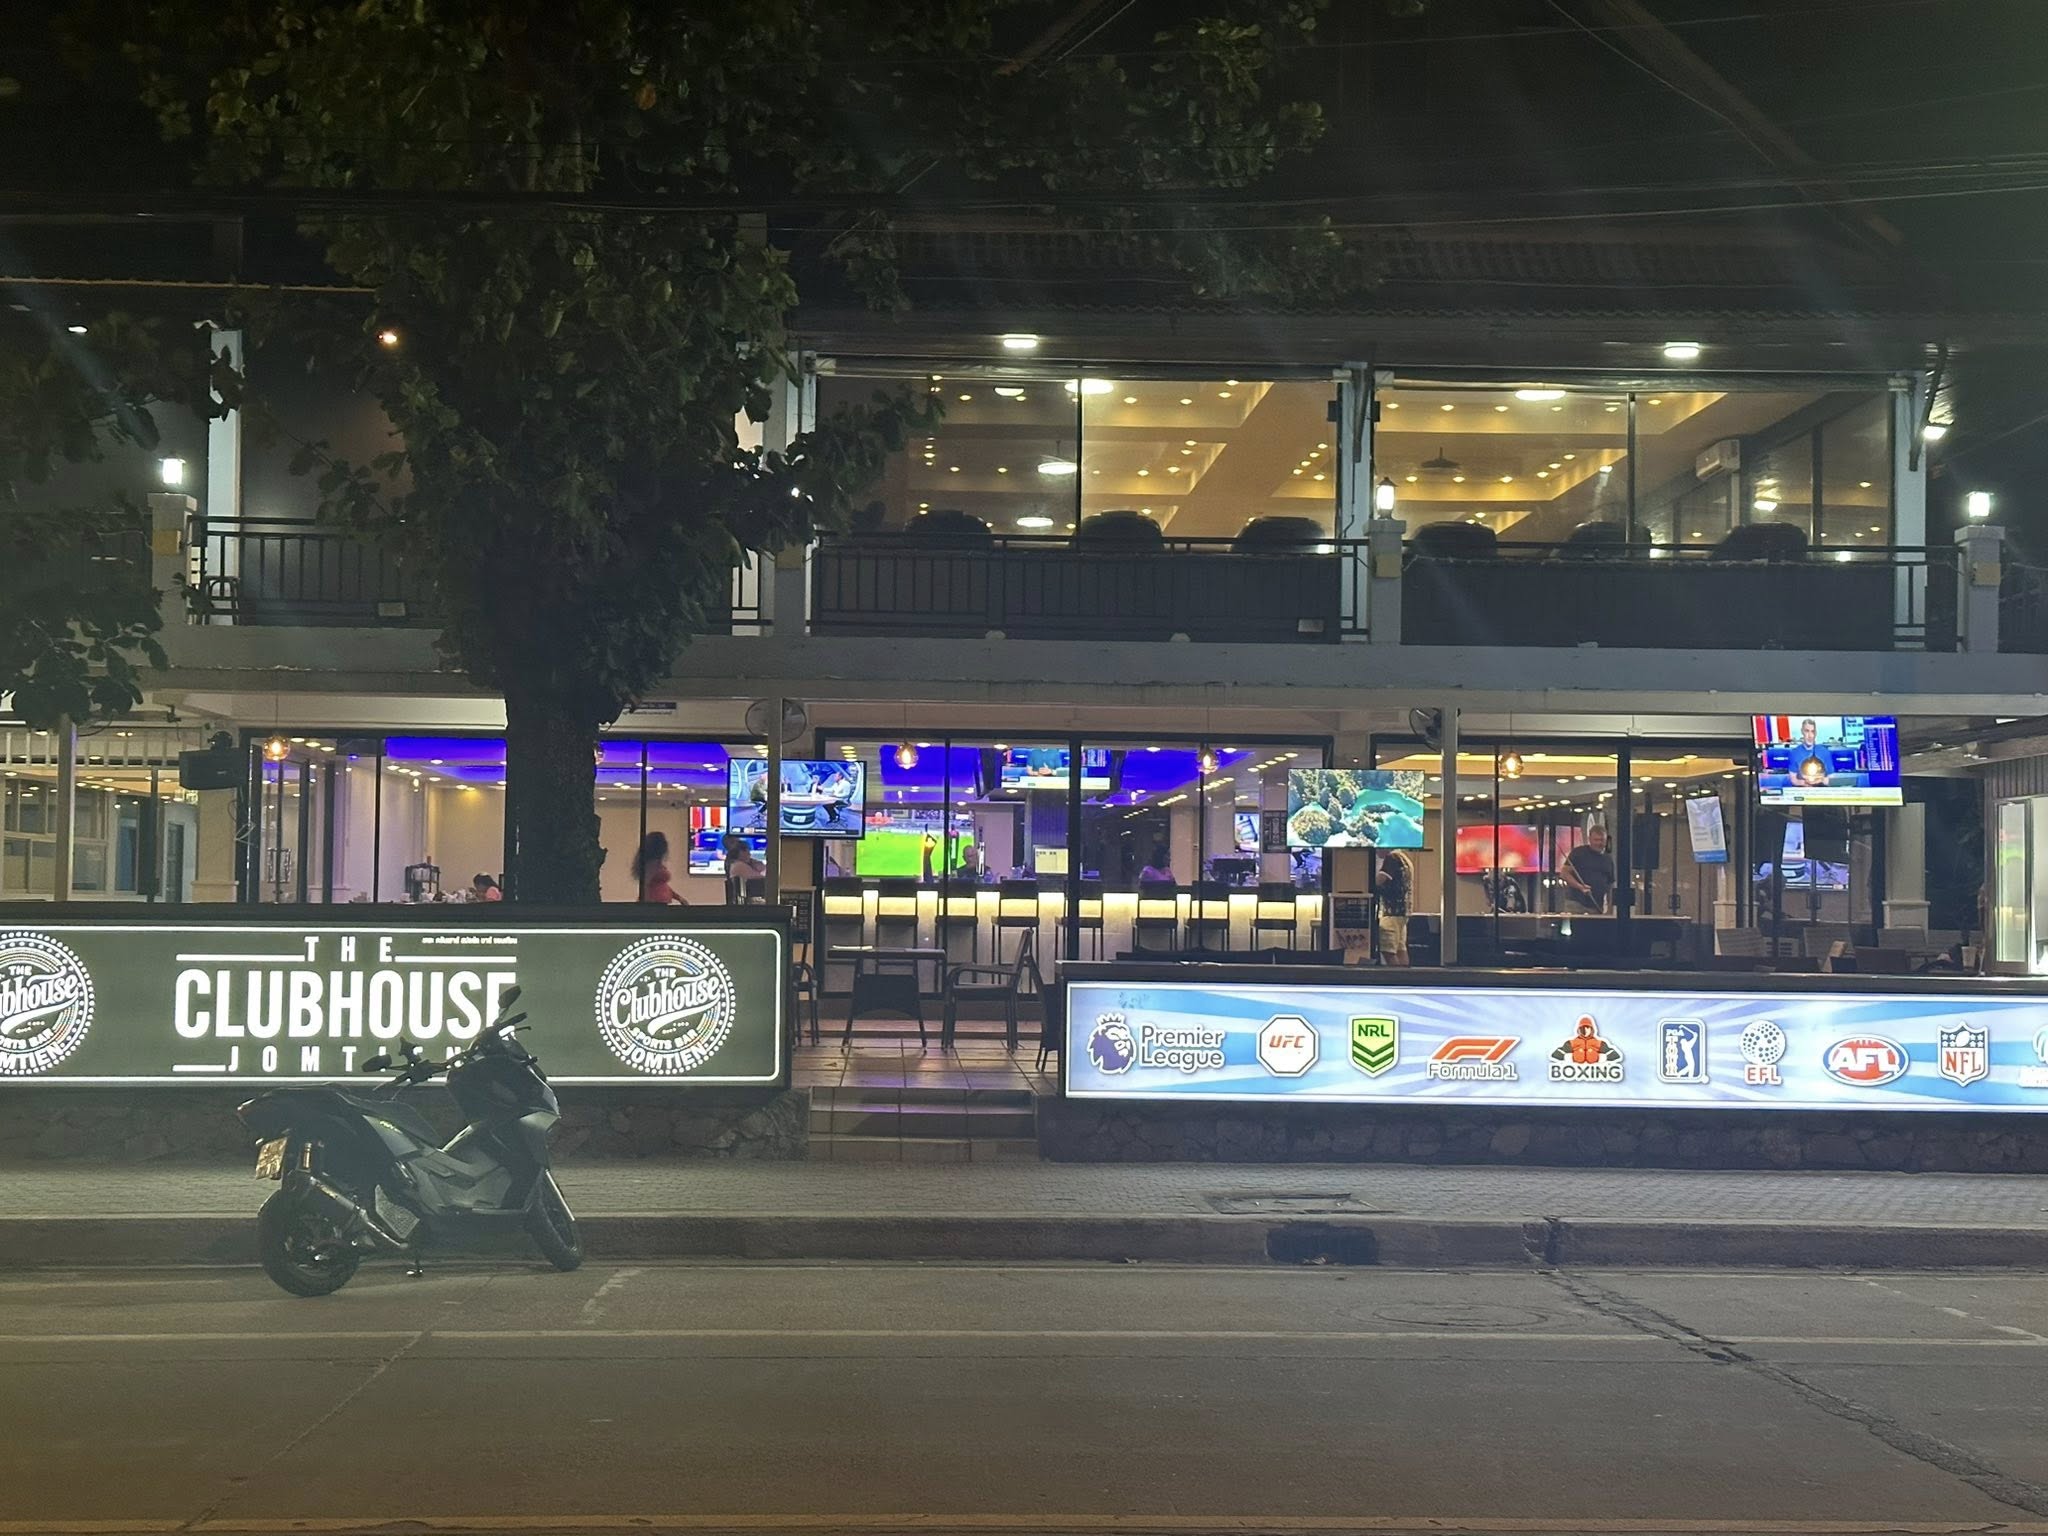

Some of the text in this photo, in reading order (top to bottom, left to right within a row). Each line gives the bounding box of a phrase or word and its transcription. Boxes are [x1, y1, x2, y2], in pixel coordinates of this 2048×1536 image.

[304, 936, 393, 962] THE
[8, 965, 33, 976] THE
[653, 967, 677, 978] THE
[175, 968, 517, 1039] CLUBHOUSE
[610, 976, 721, 1029] Clubhouse
[632, 1027, 673, 1050] SPORTS
[1142, 1025, 1223, 1045] Premier
[1269, 1035, 1306, 1048] UFC
[1358, 1024, 1390, 1037] NRL
[0, 1041, 65, 1069] MTIEN
[228, 1045, 463, 1072] JOMT
[621, 1041, 708, 1070] JOMTIEN
[1141, 1046, 1223, 1070] League
[1829, 1047, 1900, 1072] AFL
[1946, 1050, 1982, 1075] NFL
[1551, 1065, 1621, 1079] BOXING
[1747, 1067, 1779, 1081] EFL
